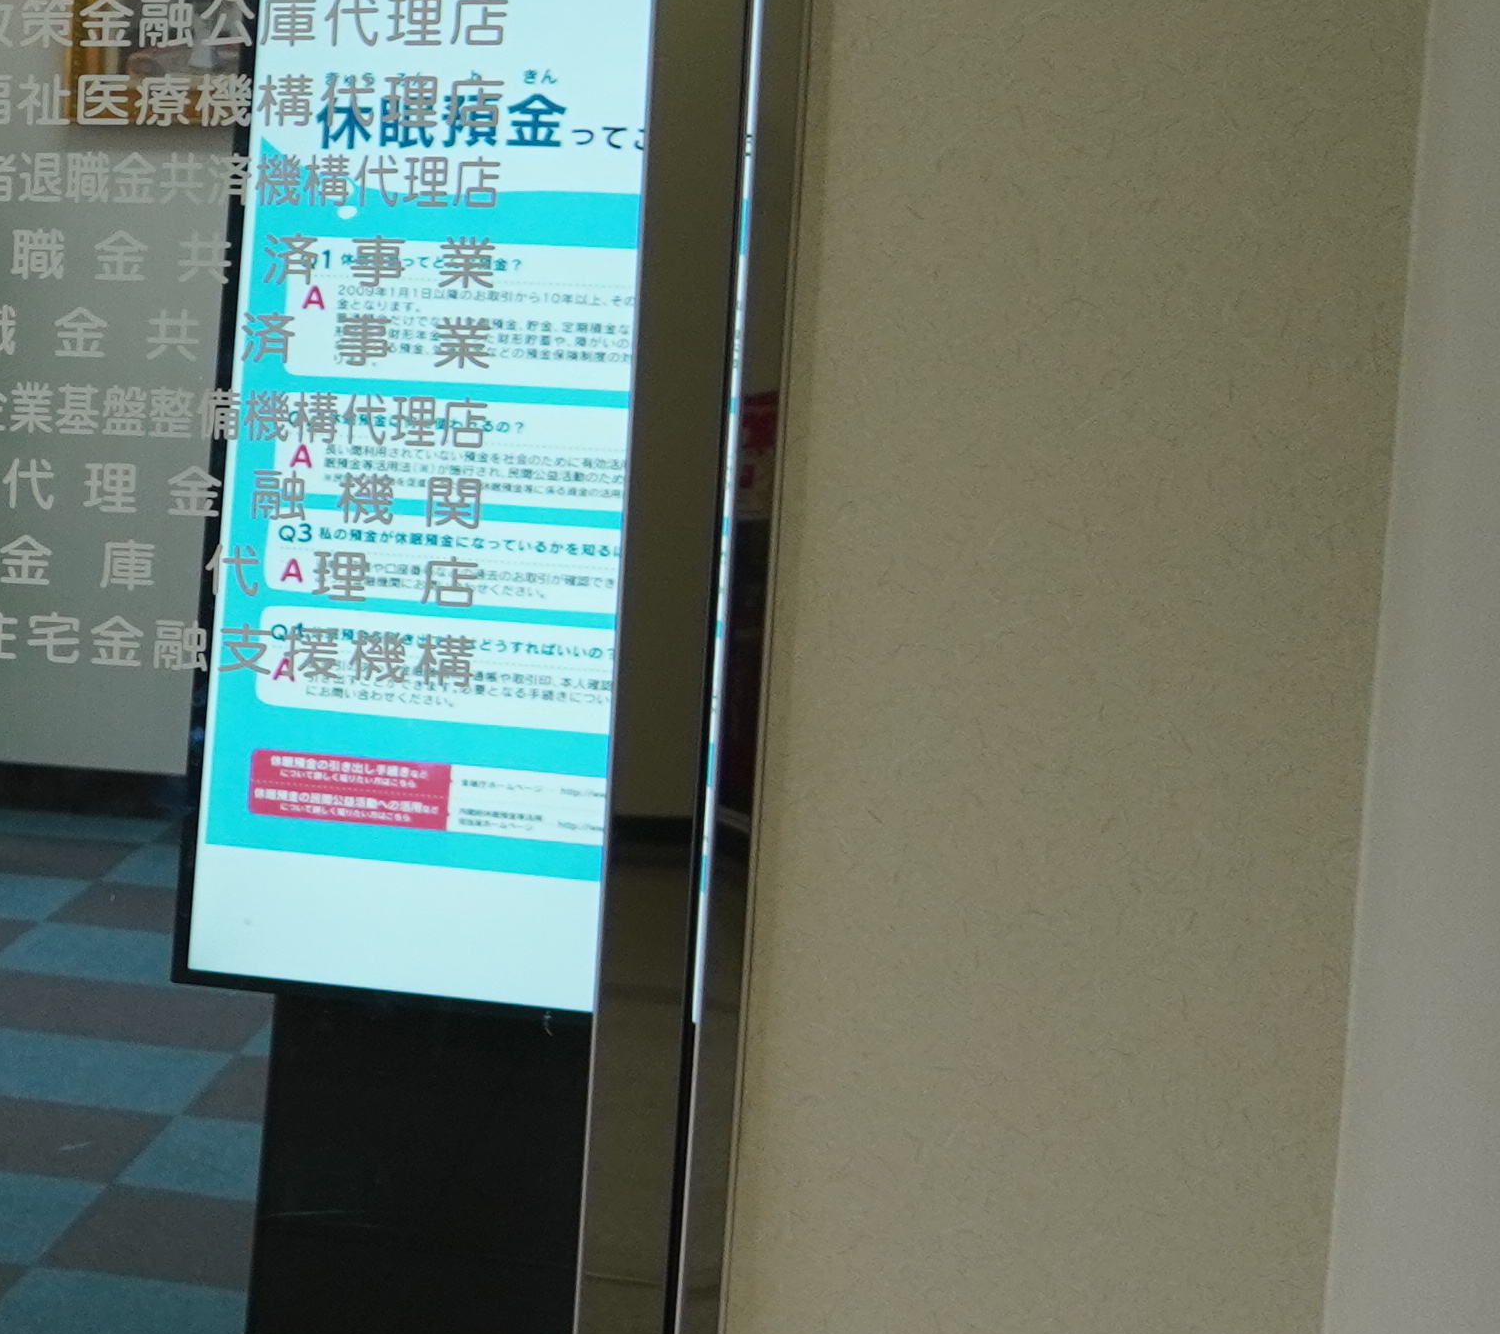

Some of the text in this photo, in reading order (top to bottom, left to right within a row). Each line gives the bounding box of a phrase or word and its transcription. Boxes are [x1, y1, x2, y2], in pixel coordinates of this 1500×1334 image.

[302, 285, 326, 310] A
[289, 443, 313, 468] A
[278, 523, 313, 544] Q3
[280, 557, 304, 583] A
